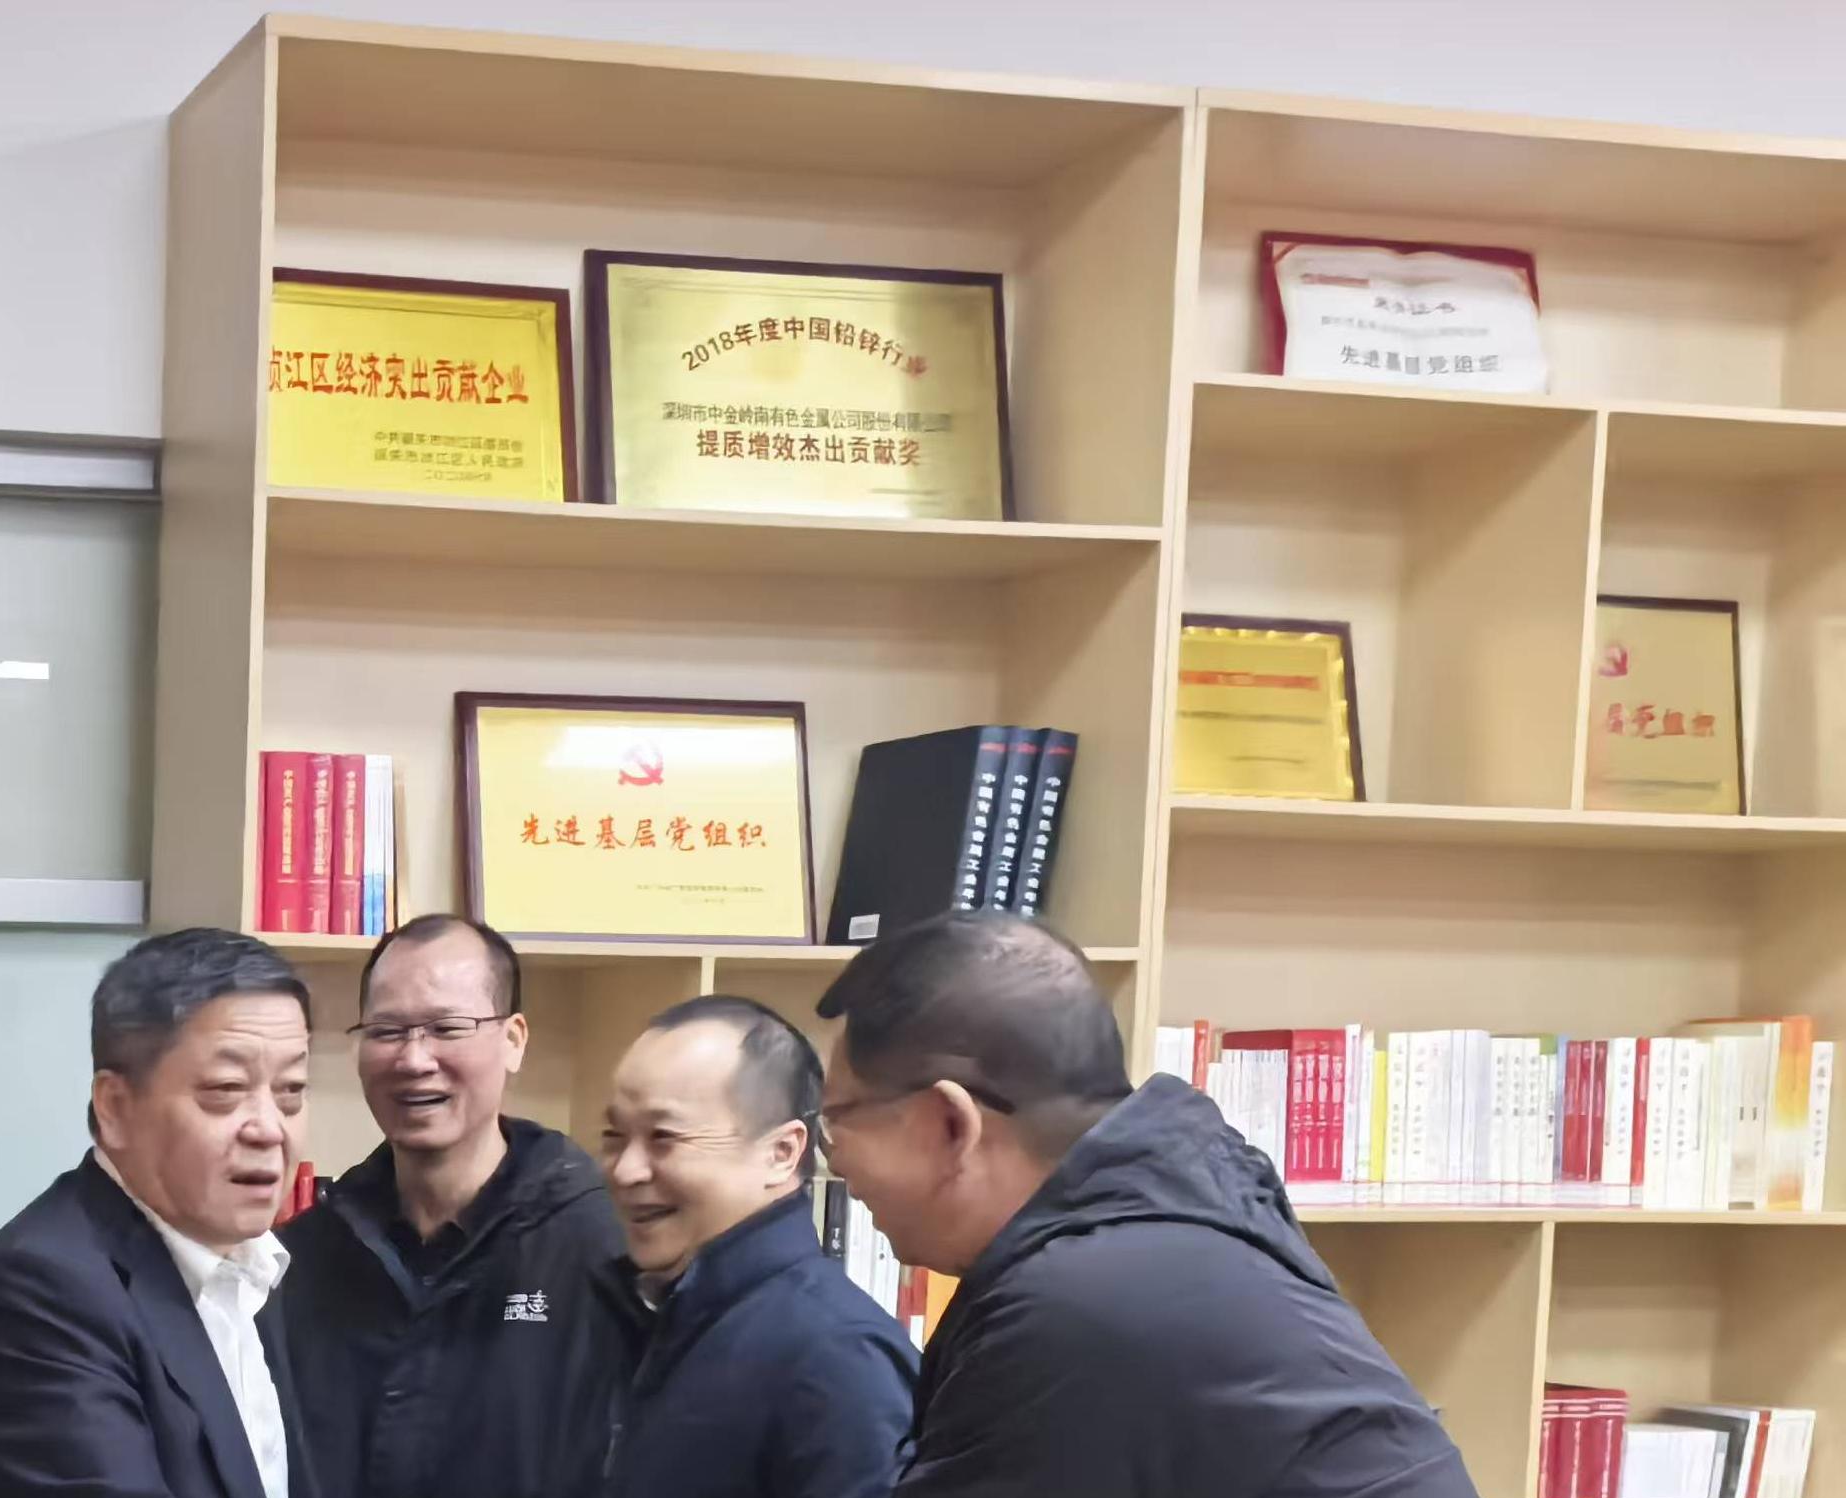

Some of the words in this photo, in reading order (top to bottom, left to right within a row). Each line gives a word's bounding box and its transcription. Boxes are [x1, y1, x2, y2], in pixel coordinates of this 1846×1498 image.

[696, 430, 922, 467] 提质增效杰出贡献奖
[520, 813, 767, 851] 先进基层党组织
